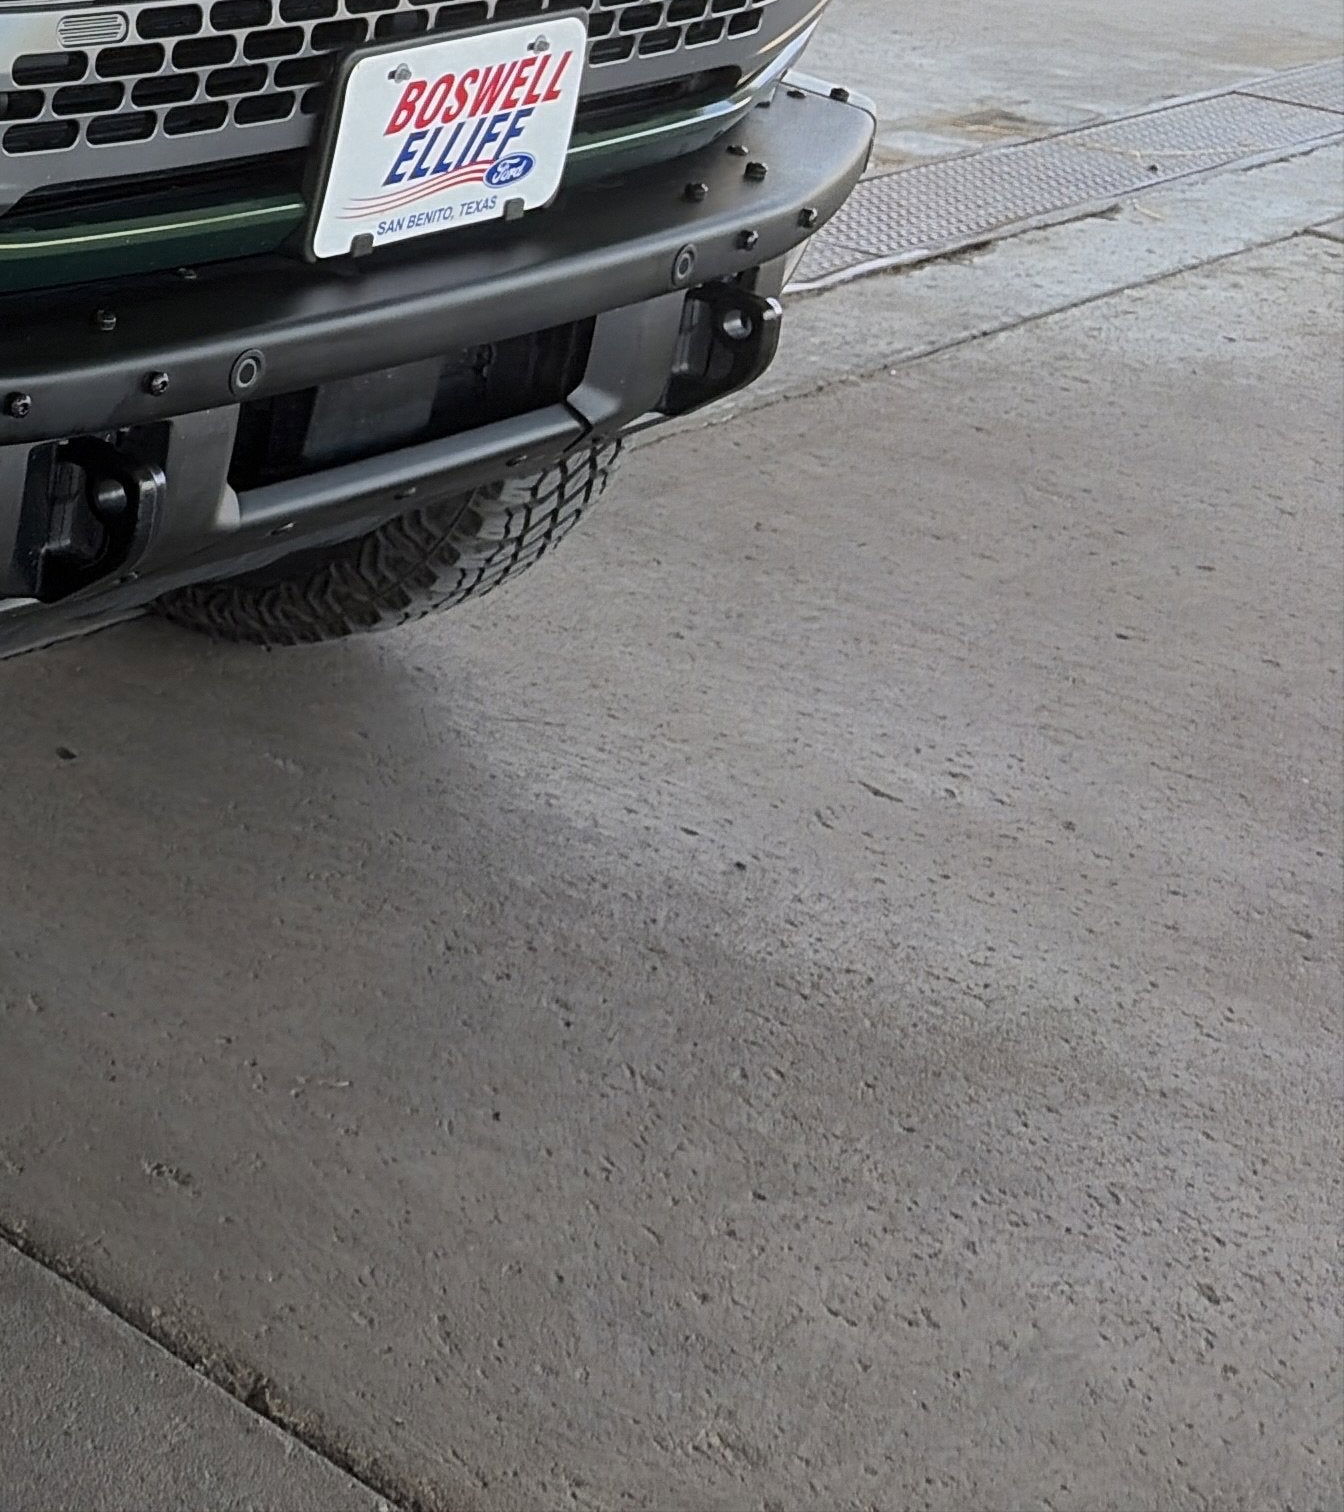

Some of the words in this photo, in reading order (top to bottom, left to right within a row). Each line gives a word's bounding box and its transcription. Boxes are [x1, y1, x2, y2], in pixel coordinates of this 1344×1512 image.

[383, 50, 573, 136] BOSWELL
[382, 107, 535, 187] ELLIFF
[492, 158, 527, 183] Ford
[377, 216, 404, 236] SAN
[407, 206, 454, 229] BENITO,
[459, 195, 498, 217] TEXAS
